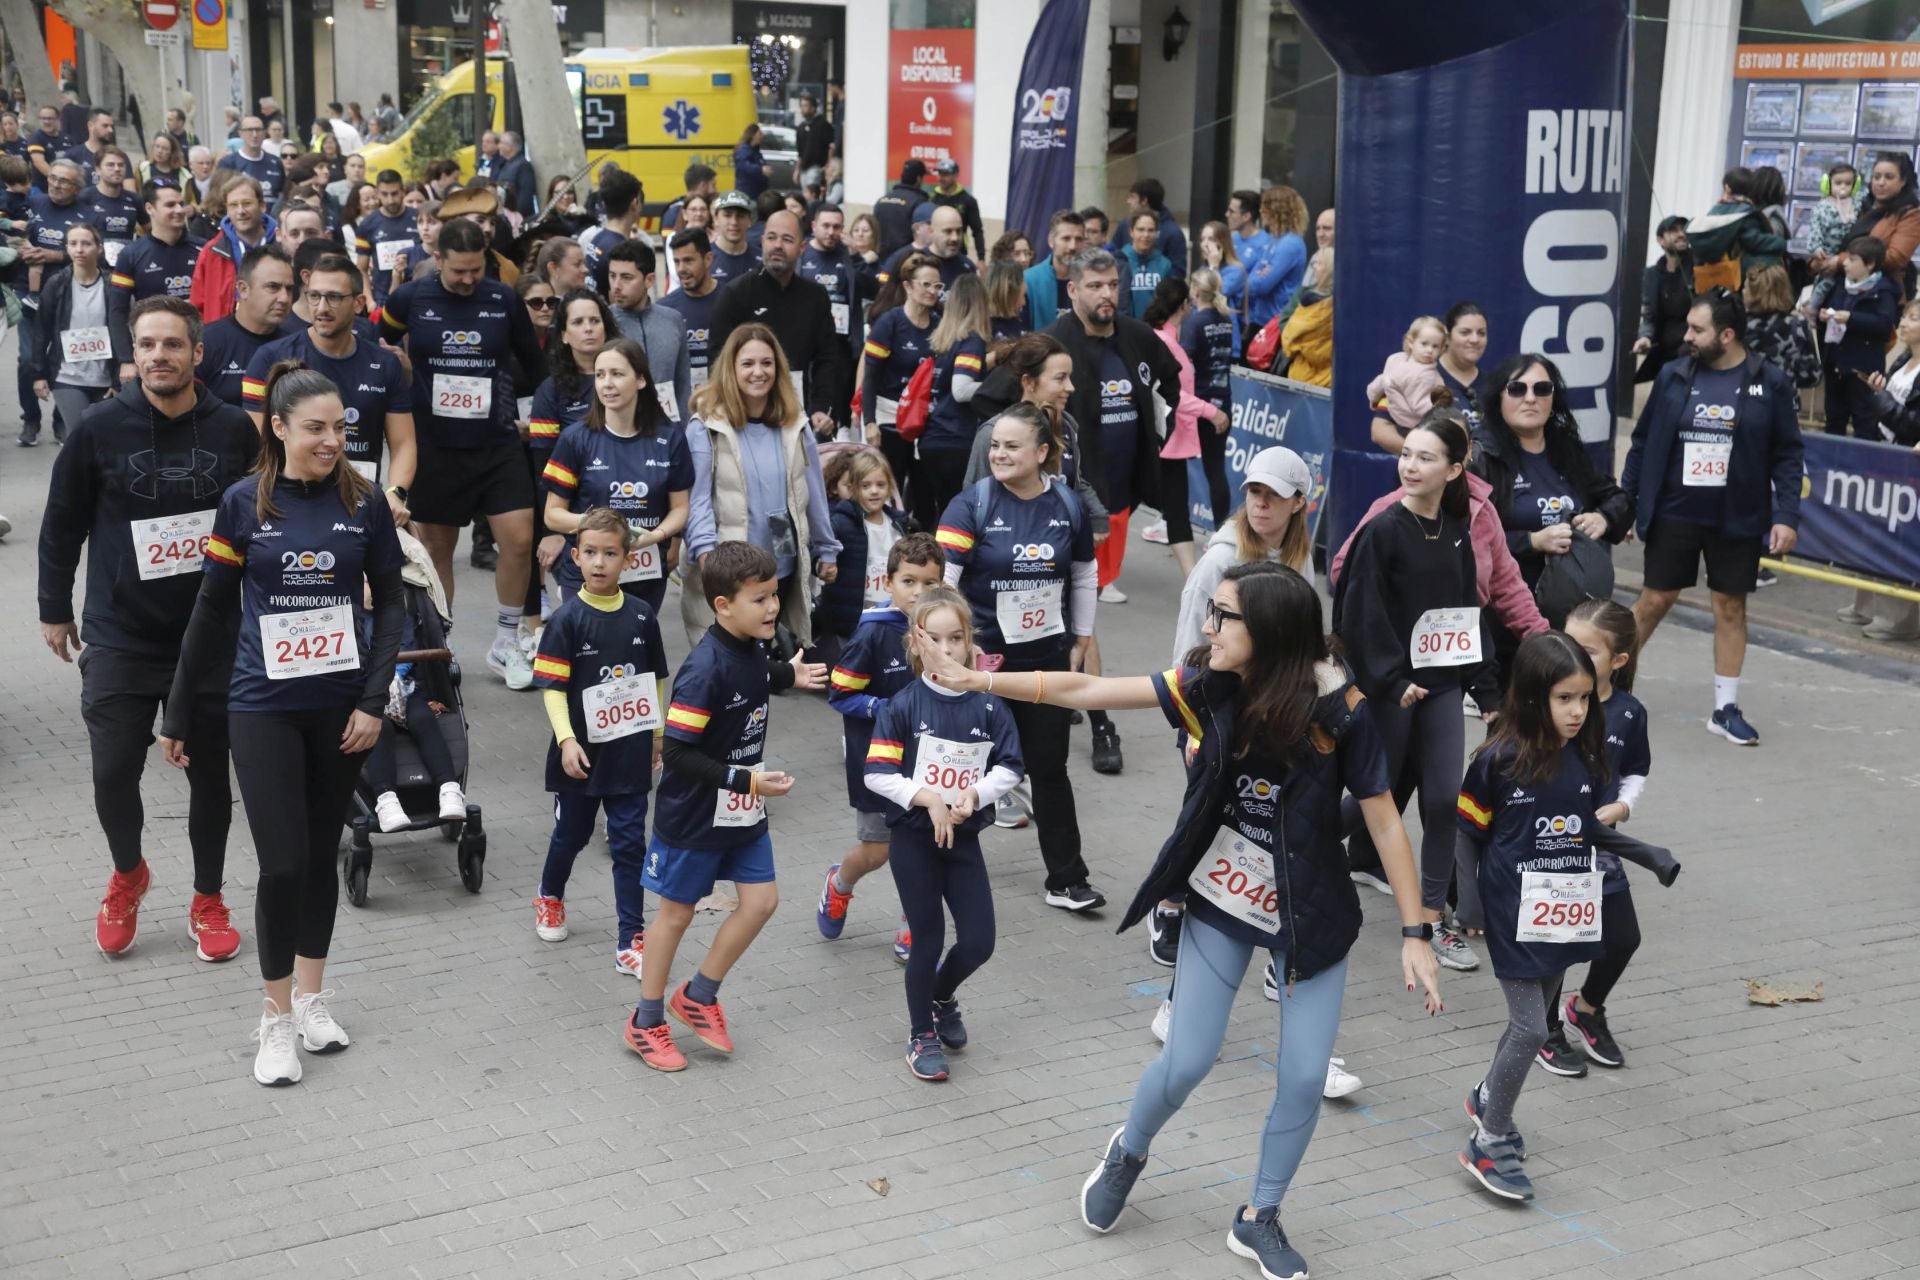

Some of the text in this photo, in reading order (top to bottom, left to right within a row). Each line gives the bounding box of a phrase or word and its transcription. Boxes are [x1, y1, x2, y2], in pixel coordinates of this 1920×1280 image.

[912, 46, 947, 63] LOCAL
[1739, 52, 1783, 69] ESTUDIO
[1785, 52, 1799, 68] DE
[1802, 52, 1885, 70] ARQUITECTURA
[1890, 52, 1898, 67] Y
[585, 74, 621, 88] NCIA
[902, 65, 961, 82] DISPONIBLE
[1525, 109, 1623, 194] RUTA
[442, 330, 481, 345] 200
[69, 340, 106, 354] 2430
[440, 392, 482, 409] 2281
[1695, 403, 1735, 420] 200
[1692, 461, 1725, 476] 243
[610, 481, 649, 498] 200
[252, 530, 282, 539] Santander
[148, 536, 210, 565] 2426
[1013, 543, 1054, 561] 200
[281, 550, 335, 572] 200
[1022, 608, 1045, 629] 52
[275, 632, 345, 663] 2427
[1418, 631, 1471, 653] 3076
[600, 663, 636, 683] 200
[883, 665, 907, 674] Santander
[596, 697, 651, 729] 3056
[725, 698, 748, 710] Santander
[744, 703, 768, 731] 200
[925, 764, 980, 790] 3065
[1506, 796, 1535, 806] Santander
[1535, 814, 1582, 837] 200
[1536, 837, 1572, 845] POLICIA
[1208, 858, 1279, 913] 2046
[1533, 902, 1595, 926] 2599
